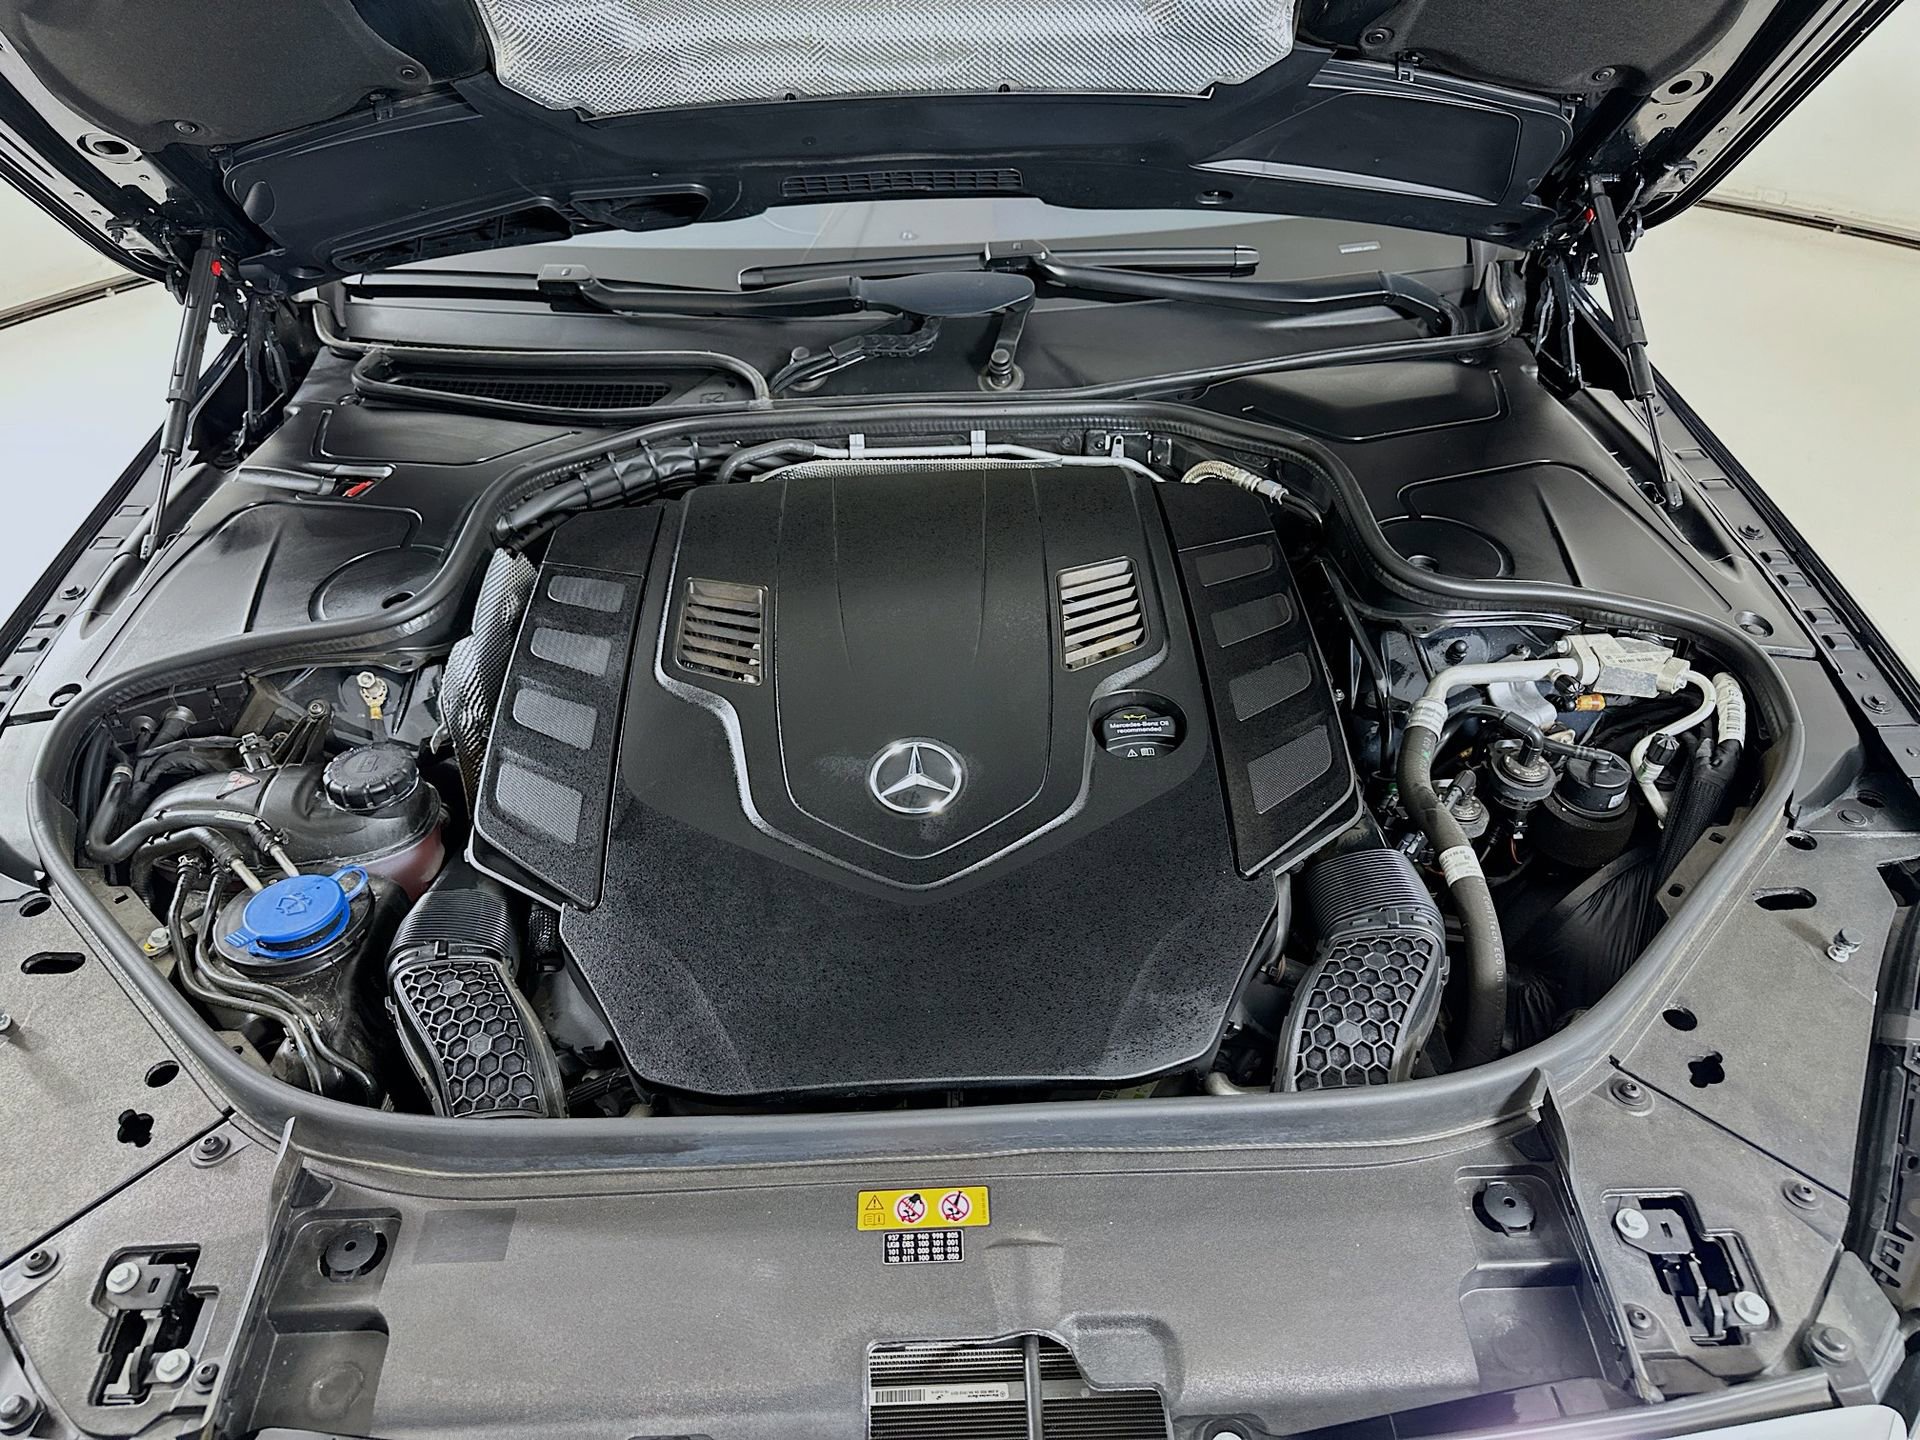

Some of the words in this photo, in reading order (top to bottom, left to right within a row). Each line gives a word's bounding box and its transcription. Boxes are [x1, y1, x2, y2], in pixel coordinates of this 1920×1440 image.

[1109, 721, 1159, 729] Mercedes-Benz
[1116, 726, 1162, 734] recommended
[1494, 947, 1503, 965] ECO
